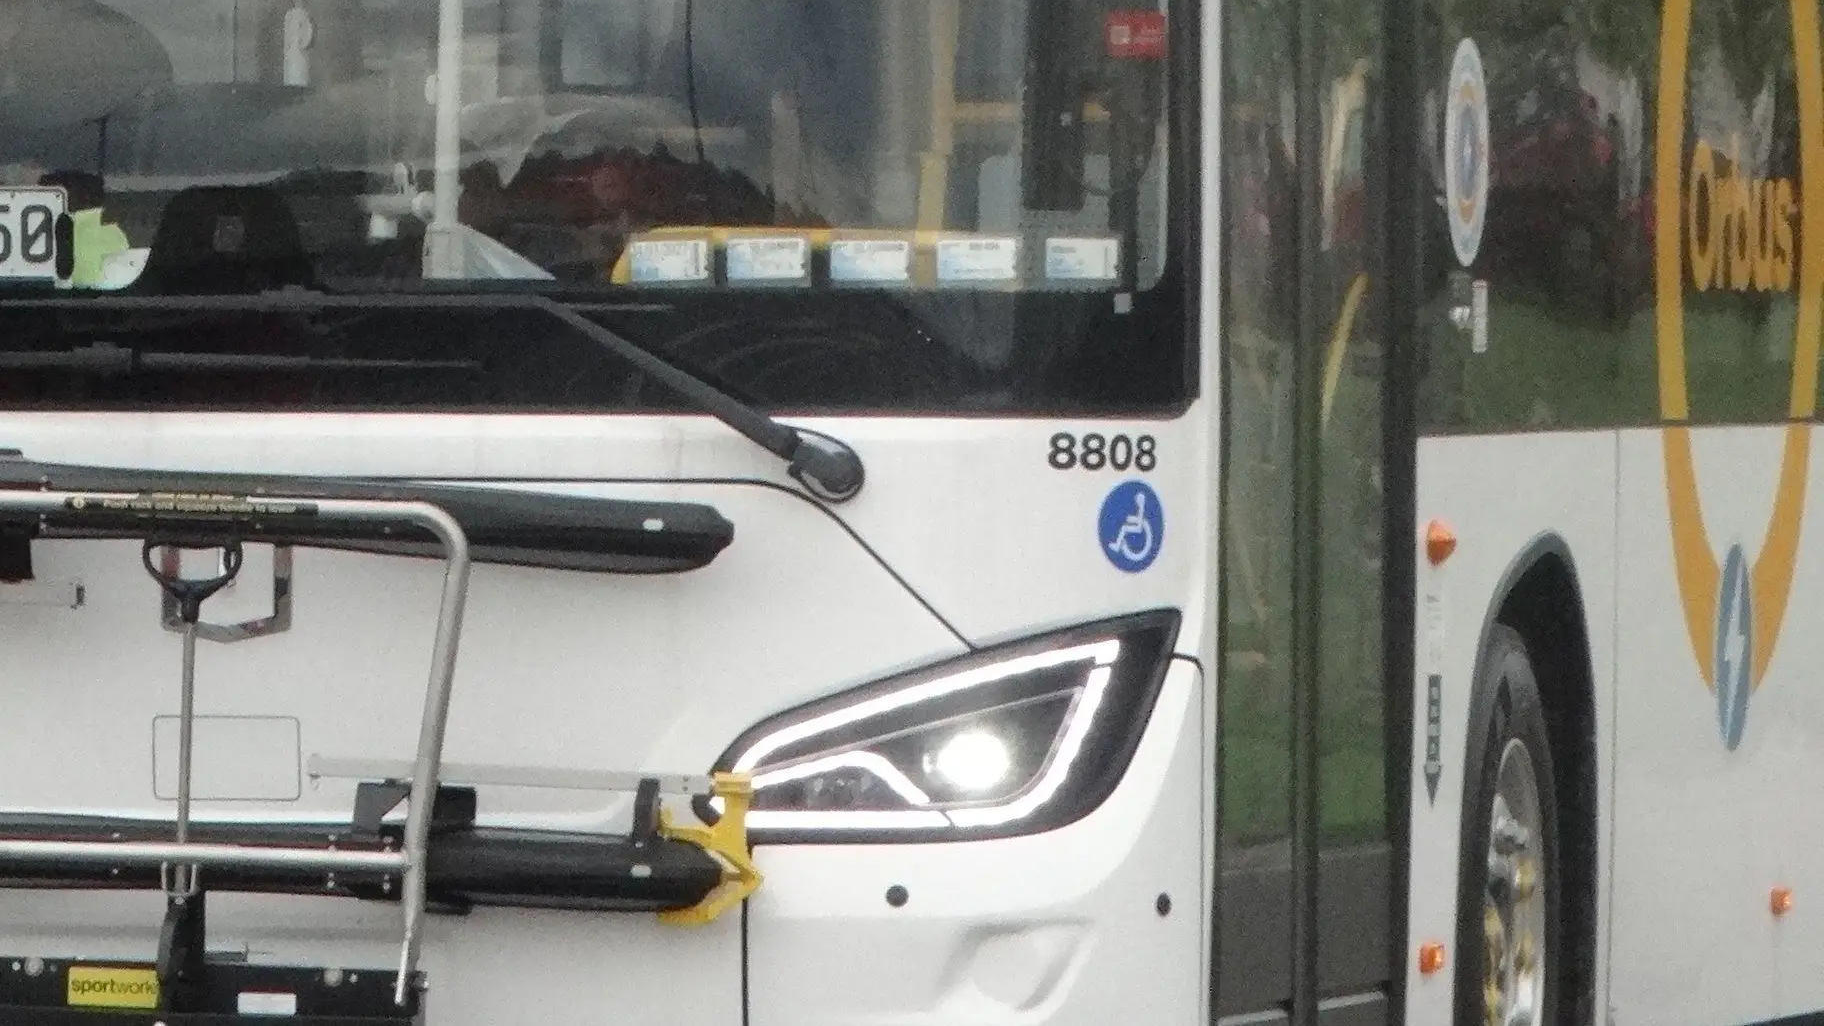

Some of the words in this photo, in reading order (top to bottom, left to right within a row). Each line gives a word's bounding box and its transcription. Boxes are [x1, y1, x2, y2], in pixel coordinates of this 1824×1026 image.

[1689, 132, 1793, 292] Orbus
[1047, 432, 1157, 473] 8808
[71, 978, 157, 995] sportwork
